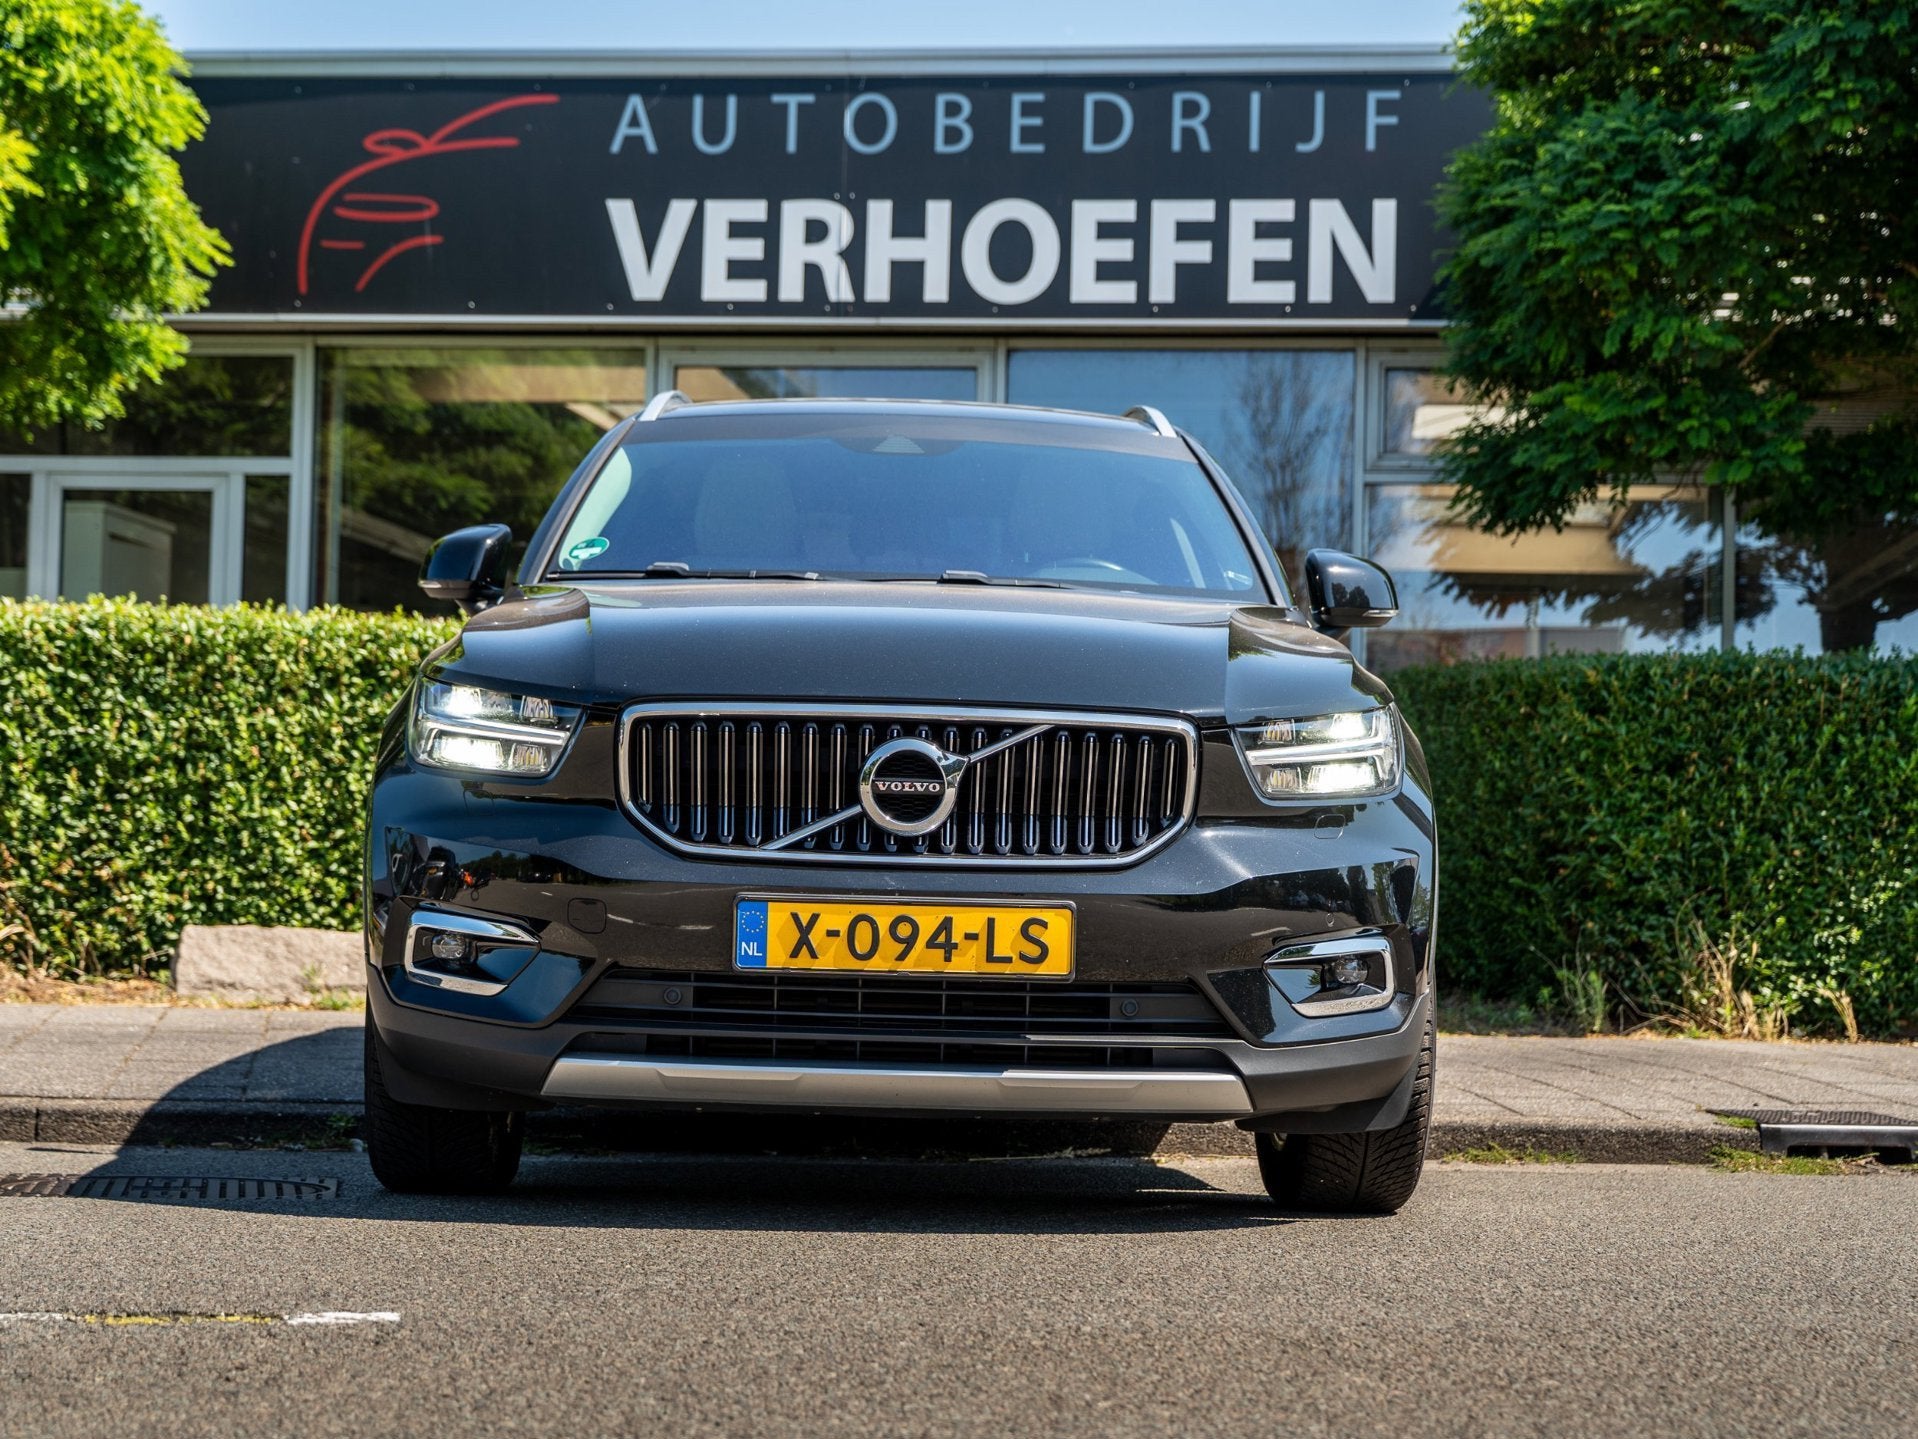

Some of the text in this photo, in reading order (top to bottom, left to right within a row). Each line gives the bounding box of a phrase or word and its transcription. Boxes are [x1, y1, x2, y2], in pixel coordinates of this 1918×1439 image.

[609, 91, 1402, 154] AUTOBEDRIJF
[605, 198, 1399, 304] VERHOEFEN
[876, 781, 941, 793] VOLVO
[741, 942, 763, 957] NL
[789, 912, 1050, 964] X-094-LS
